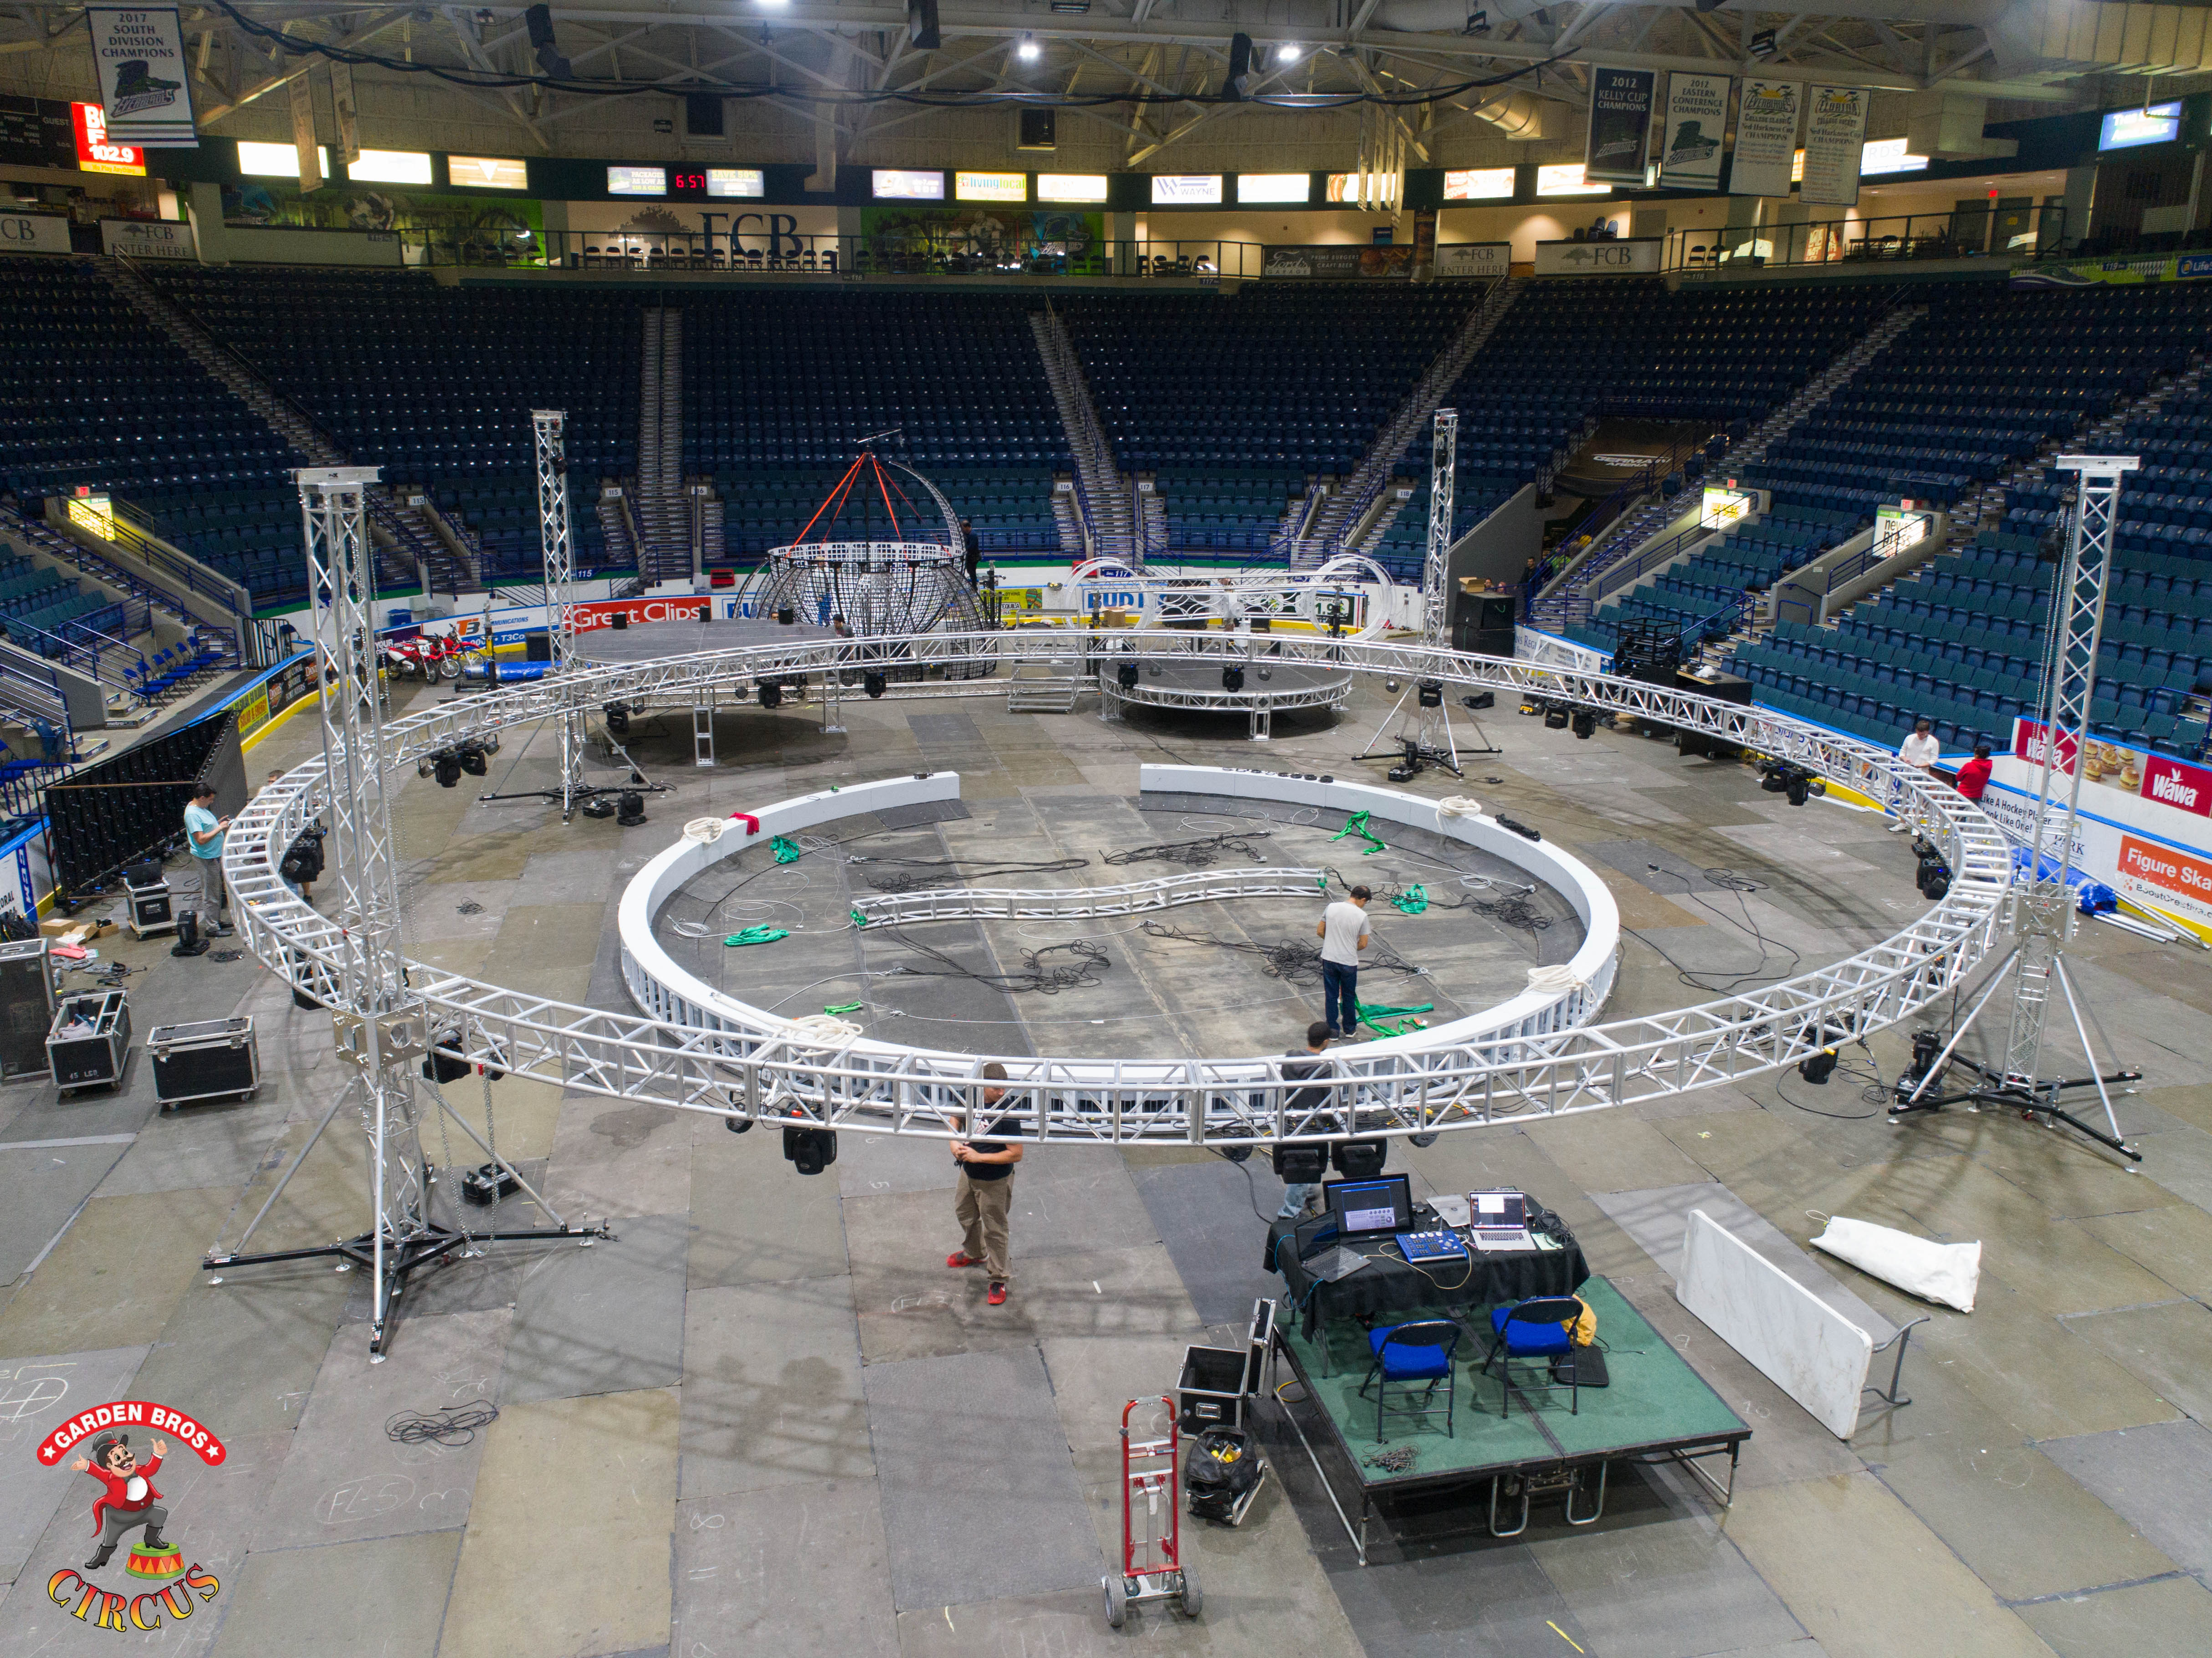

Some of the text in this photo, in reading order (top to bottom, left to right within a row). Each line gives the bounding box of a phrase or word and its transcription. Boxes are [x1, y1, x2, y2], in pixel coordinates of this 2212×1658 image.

[119, 14, 146, 22] 2017
[114, 25, 155, 34] SOUTH
[108, 36, 164, 46] DIVISION
[102, 48, 174, 58] CHAMPIONS
[1611, 76, 1637, 88] 2012
[1690, 80, 1709, 88] 2012
[1598, 90, 1648, 102] KELLY CUP
[1682, 88, 1716, 97] EASTERN
[1598, 101, 1646, 112] CHAMPIONS
[1672, 97, 1723, 107] CONFERENCE
[1673, 106, 1720, 116] CHAMPIONS
[43, 117, 70, 126] GUEST
[89, 144, 134, 163] 102.9
[712, 170, 758, 179] SAVE 50%
[0, 219, 35, 240] CB
[145, 225, 174, 240] FCB
[697, 212, 804, 260] FCB
[112, 243, 188, 257] ENTER HERE
[1471, 249, 1494, 260] FCB
[1594, 246, 1632, 265] FCB
[1440, 265, 1506, 275] ENTER HERE
[1882, 531, 1912, 548] press
[578, 569, 592, 578] 115
[1088, 593, 1134, 609] BUD
[644, 603, 700, 622] Clips
[456, 618, 481, 636] T3
[374, 639, 393, 649] YOUR
[2153, 773, 2197, 807] Wawa
[1979, 793, 1994, 807] Like
[1994, 799, 2001, 808] A
[1999, 814, 2014, 827] Like
[2015, 819, 2033, 834] One!
[2127, 847, 2177, 878] Figure
